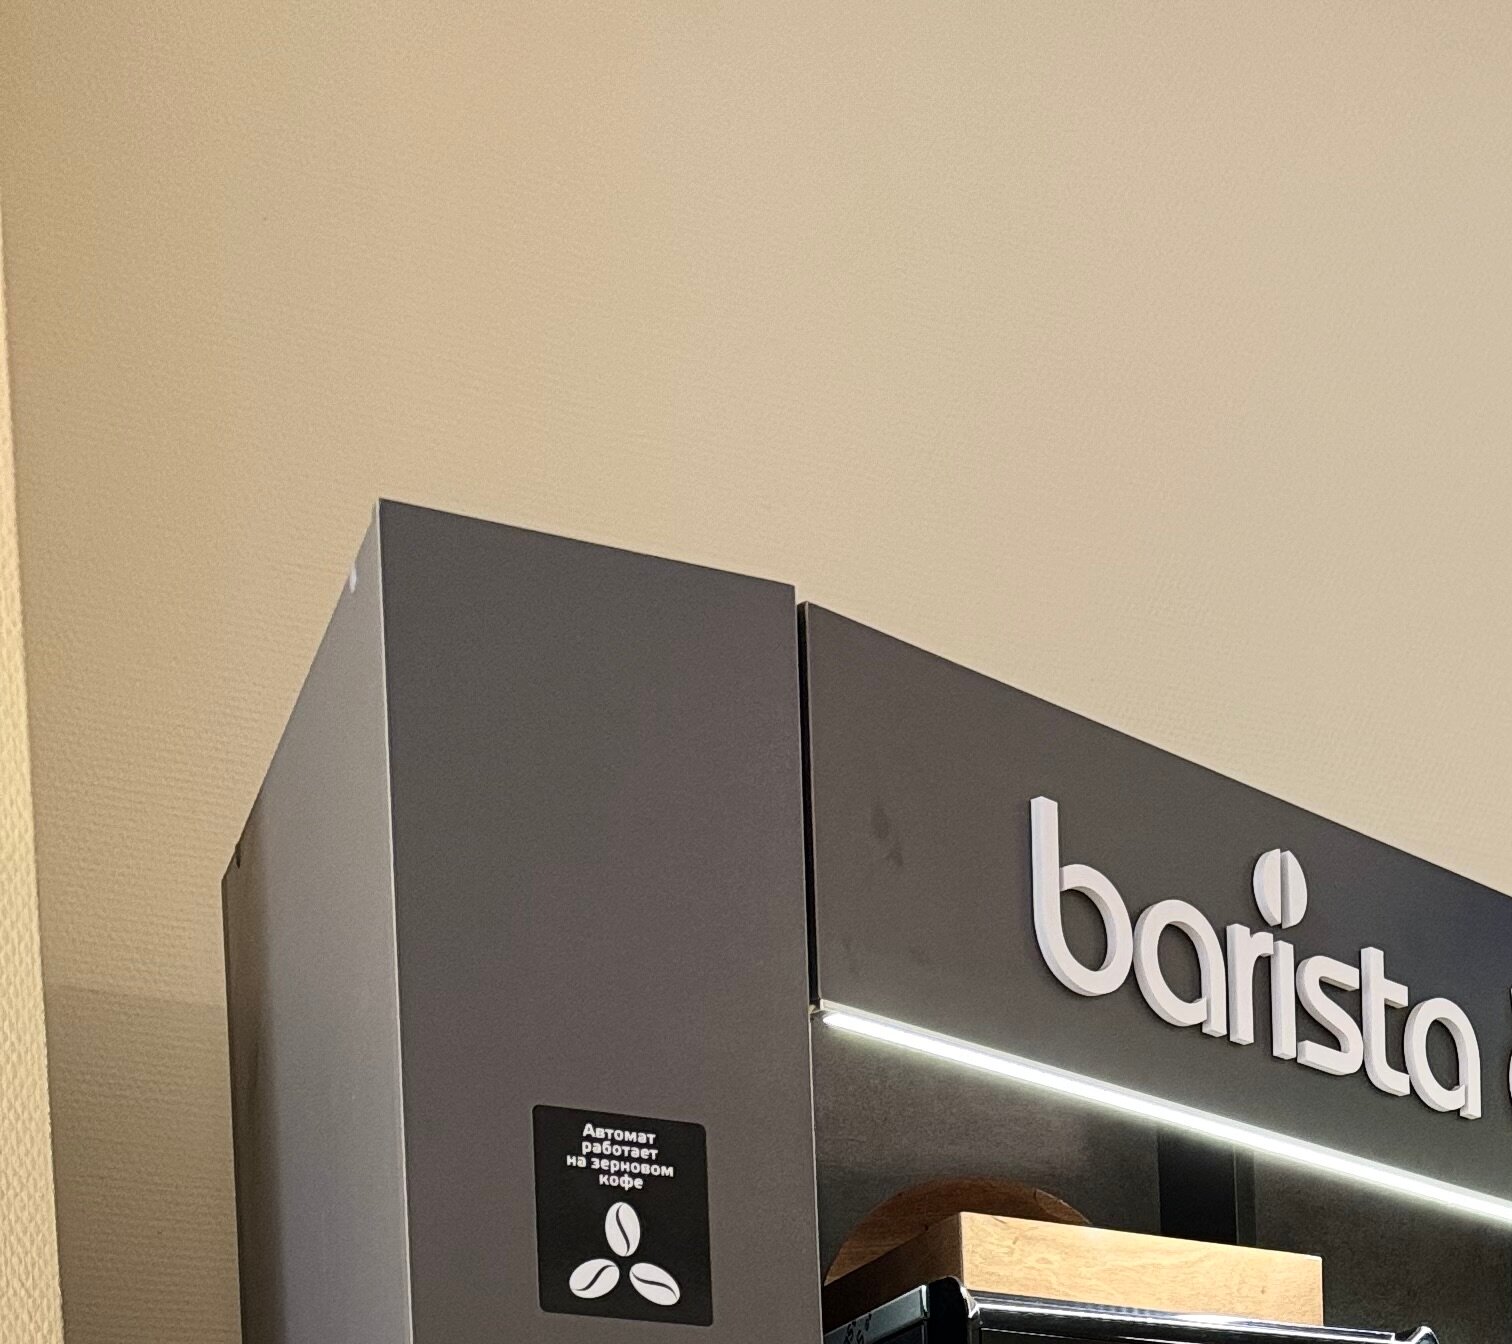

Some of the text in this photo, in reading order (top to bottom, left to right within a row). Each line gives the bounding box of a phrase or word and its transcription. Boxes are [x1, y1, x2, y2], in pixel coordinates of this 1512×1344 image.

[1030, 796, 1482, 1120] barista
[582, 1122, 656, 1145] Автомат
[581, 1141, 659, 1161] работает
[566, 1154, 674, 1178] на зерновом
[599, 1172, 644, 1191] кофе
